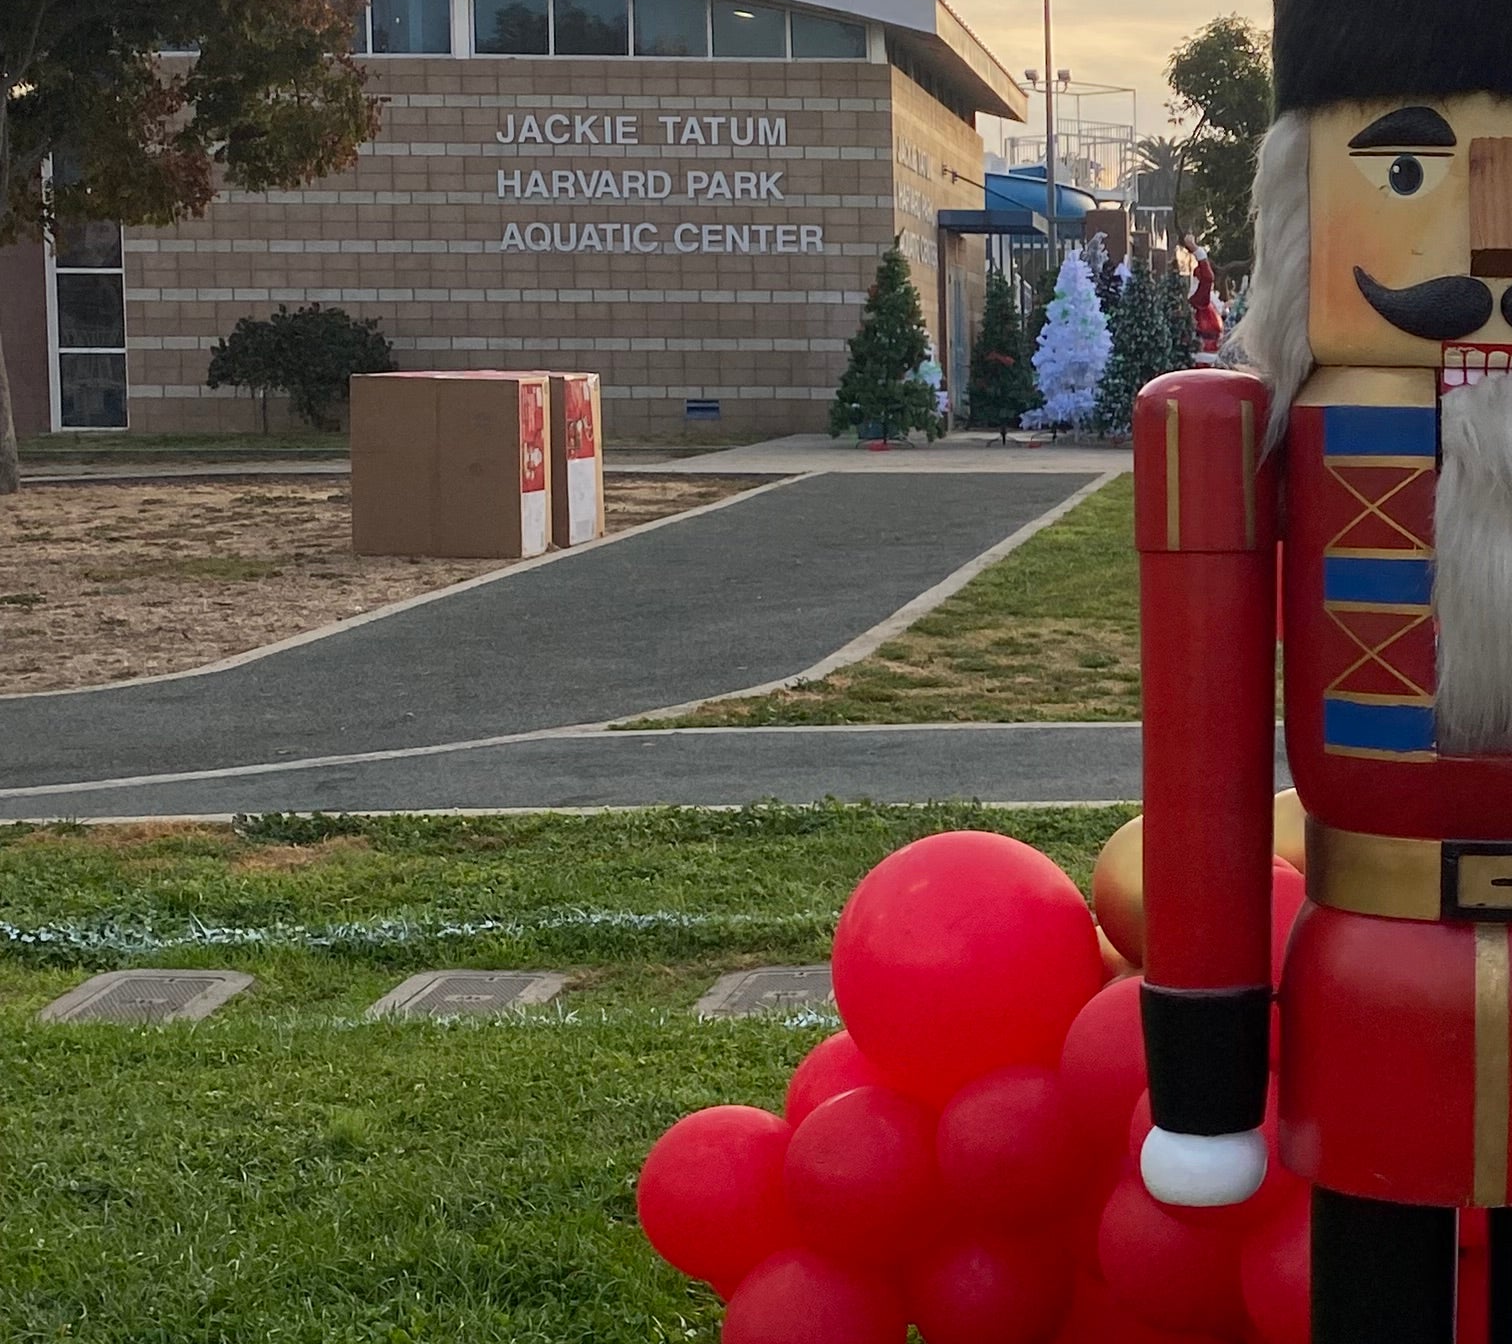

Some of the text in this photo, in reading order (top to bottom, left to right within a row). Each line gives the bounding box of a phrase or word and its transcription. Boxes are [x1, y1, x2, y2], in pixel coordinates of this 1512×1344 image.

[496, 114, 786, 146] JACKIE TATUM
[497, 169, 784, 200] HARVARD PARK
[500, 222, 824, 253] AQUATIC CENTER
